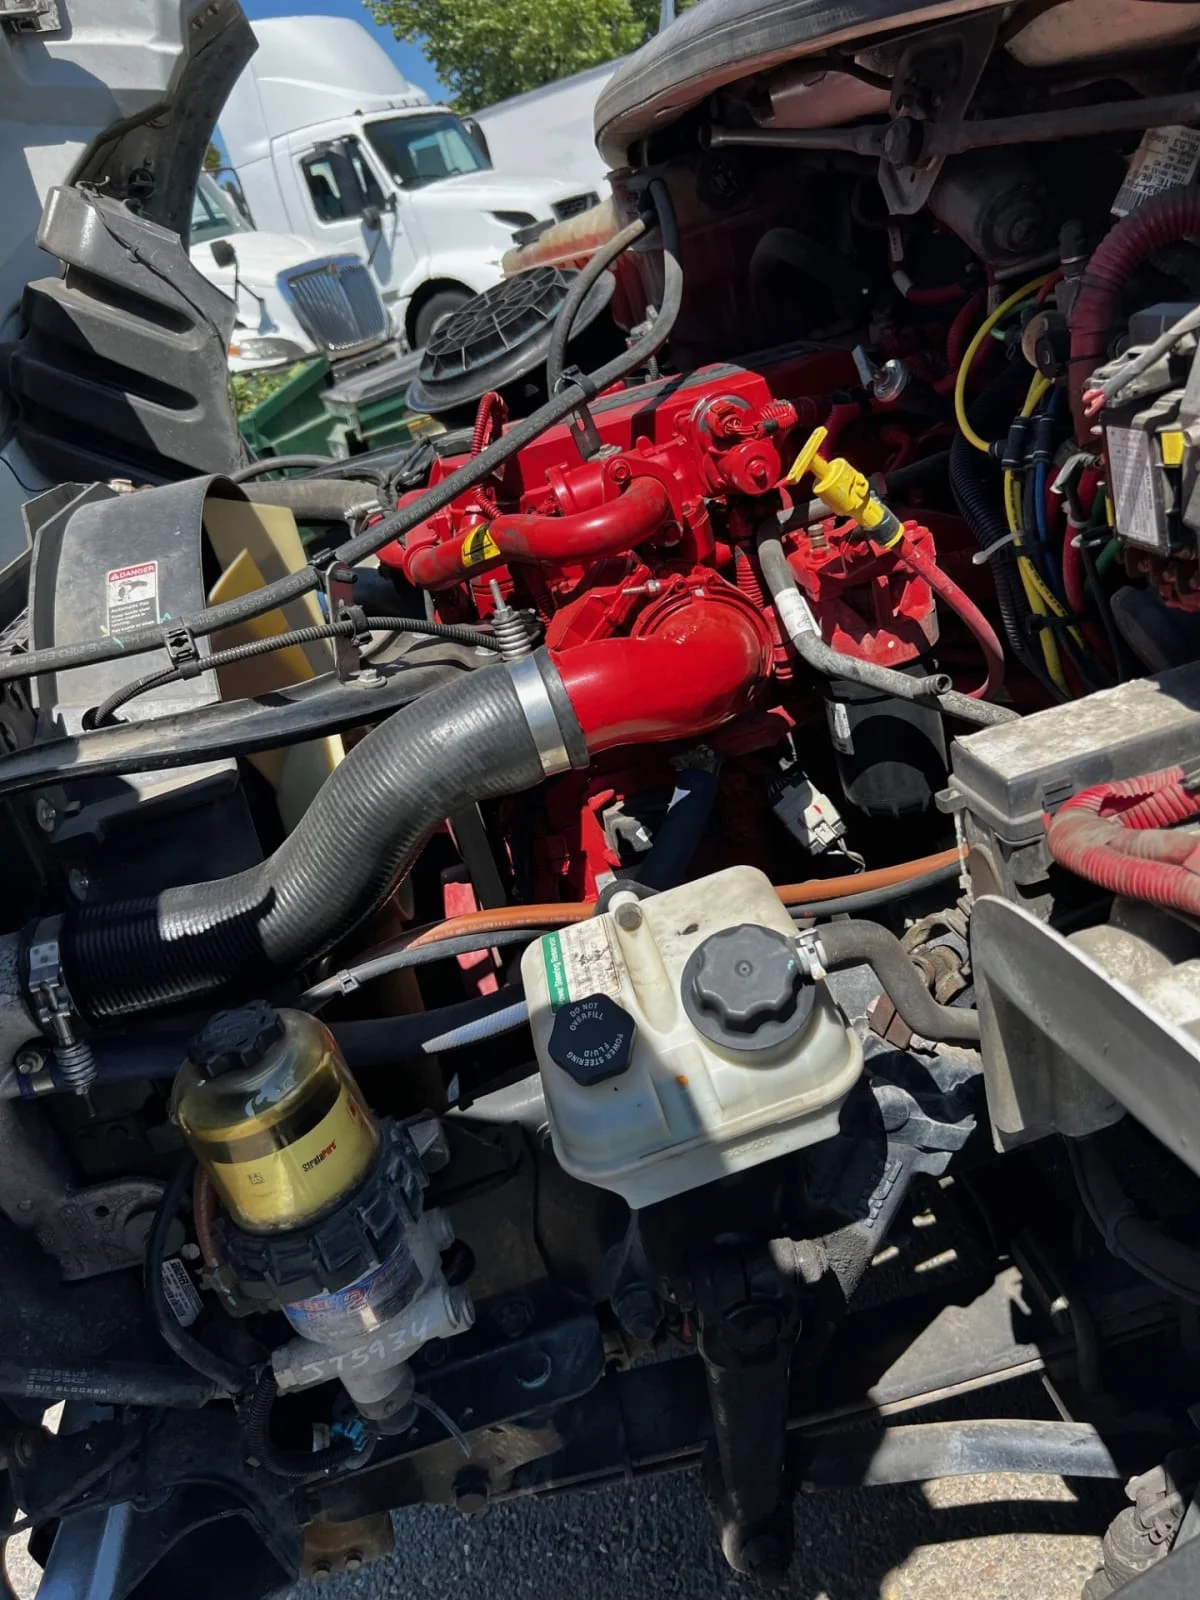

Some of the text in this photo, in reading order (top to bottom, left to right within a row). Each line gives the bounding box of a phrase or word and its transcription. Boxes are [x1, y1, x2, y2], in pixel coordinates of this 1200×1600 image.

[120, 565, 155, 577] DANGER
[570, 1002, 599, 1018] DO NOT
[569, 1012, 604, 1031] OVERFILL
[566, 1033, 624, 1067] POWER STEERING
[584, 1042, 610, 1057] FLUID
